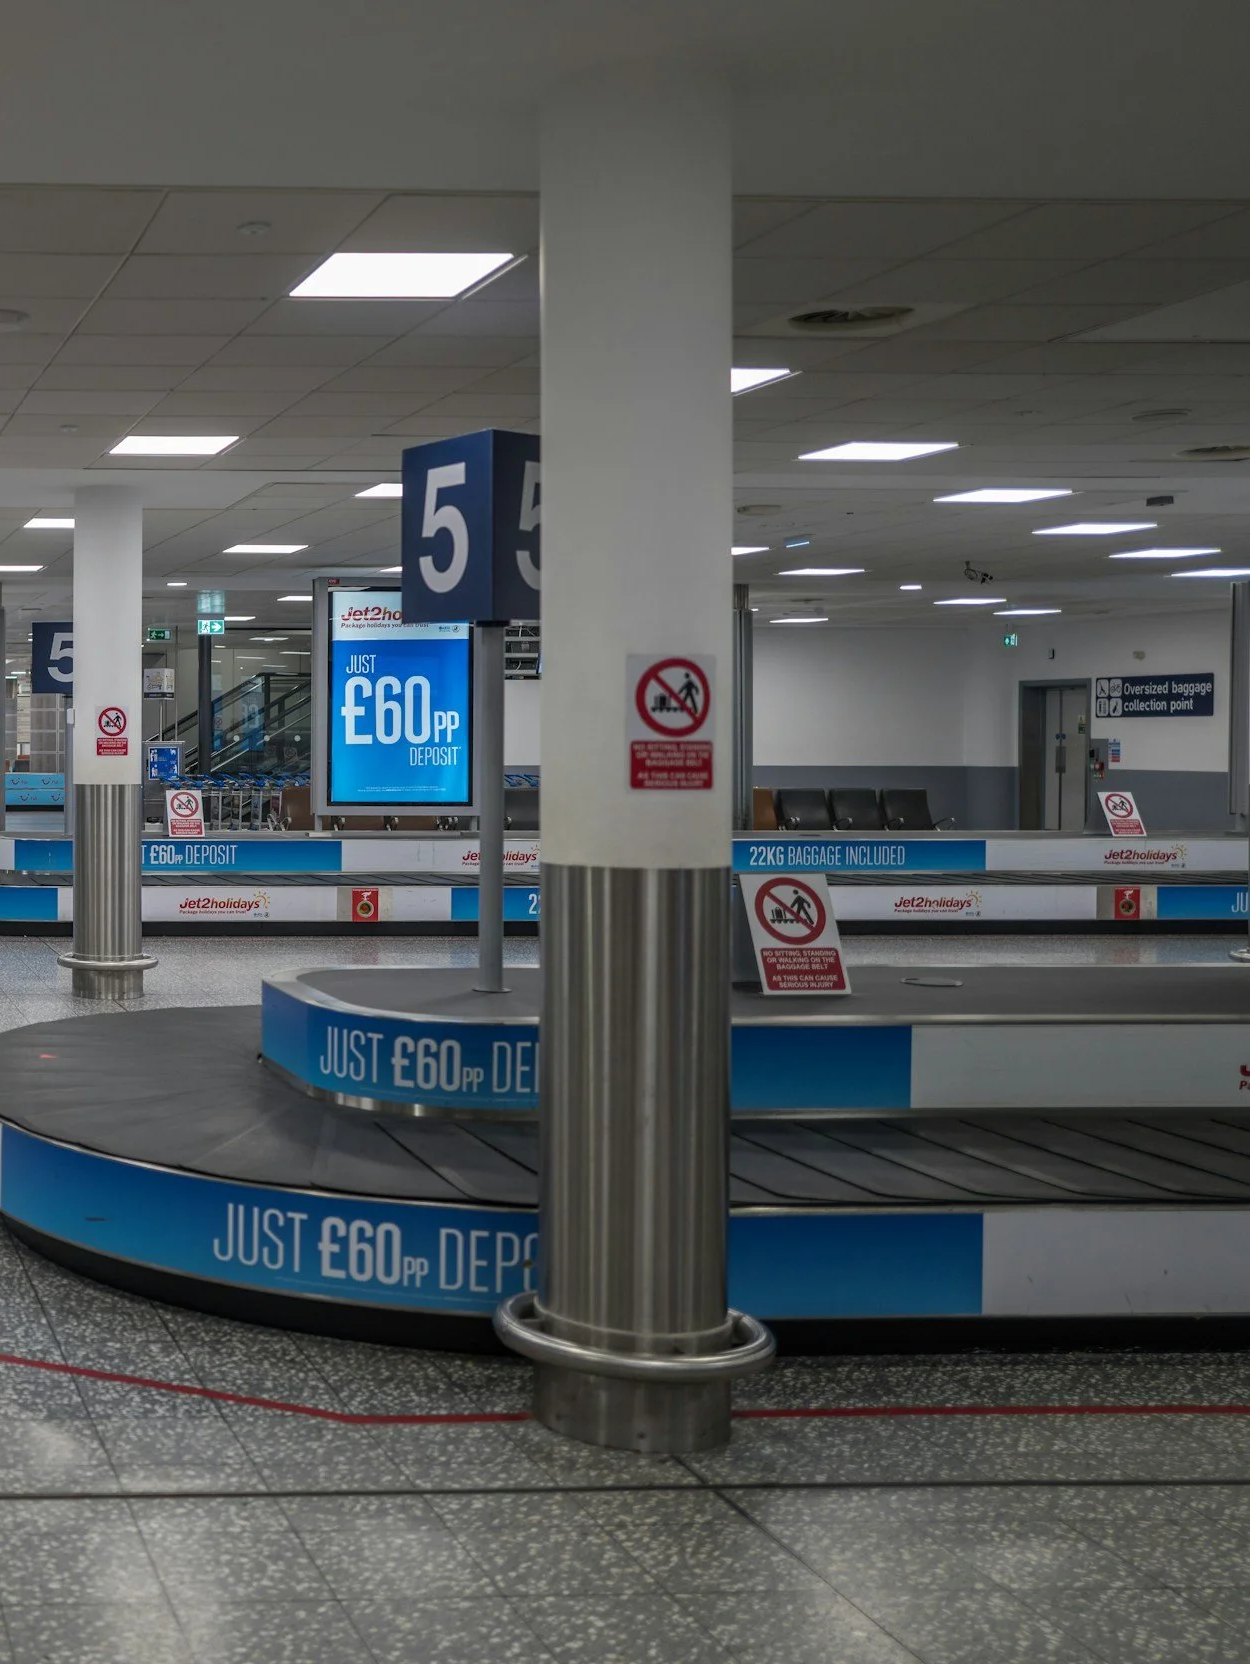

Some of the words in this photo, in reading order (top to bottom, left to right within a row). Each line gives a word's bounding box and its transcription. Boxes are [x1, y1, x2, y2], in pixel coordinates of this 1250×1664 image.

[419, 461, 469, 593] 5
[47, 632, 74, 683] 5
[346, 654, 377, 674] JUST
[1123, 681, 1169, 695] Oversized
[1171, 681, 1213, 696] baggage
[1123, 699, 1167, 712] collection
[1169, 698, 1194, 713] point
[185, 844, 238, 865] DEPOSIT
[749, 846, 785, 866] 22KG
[787, 846, 842, 866] BAGGAGE
[845, 845, 905, 866] INCLUDED
[320, 1026, 384, 1083] JUST
[213, 1203, 308, 1273] JUST
[439, 1228, 539, 1294] DEPO
